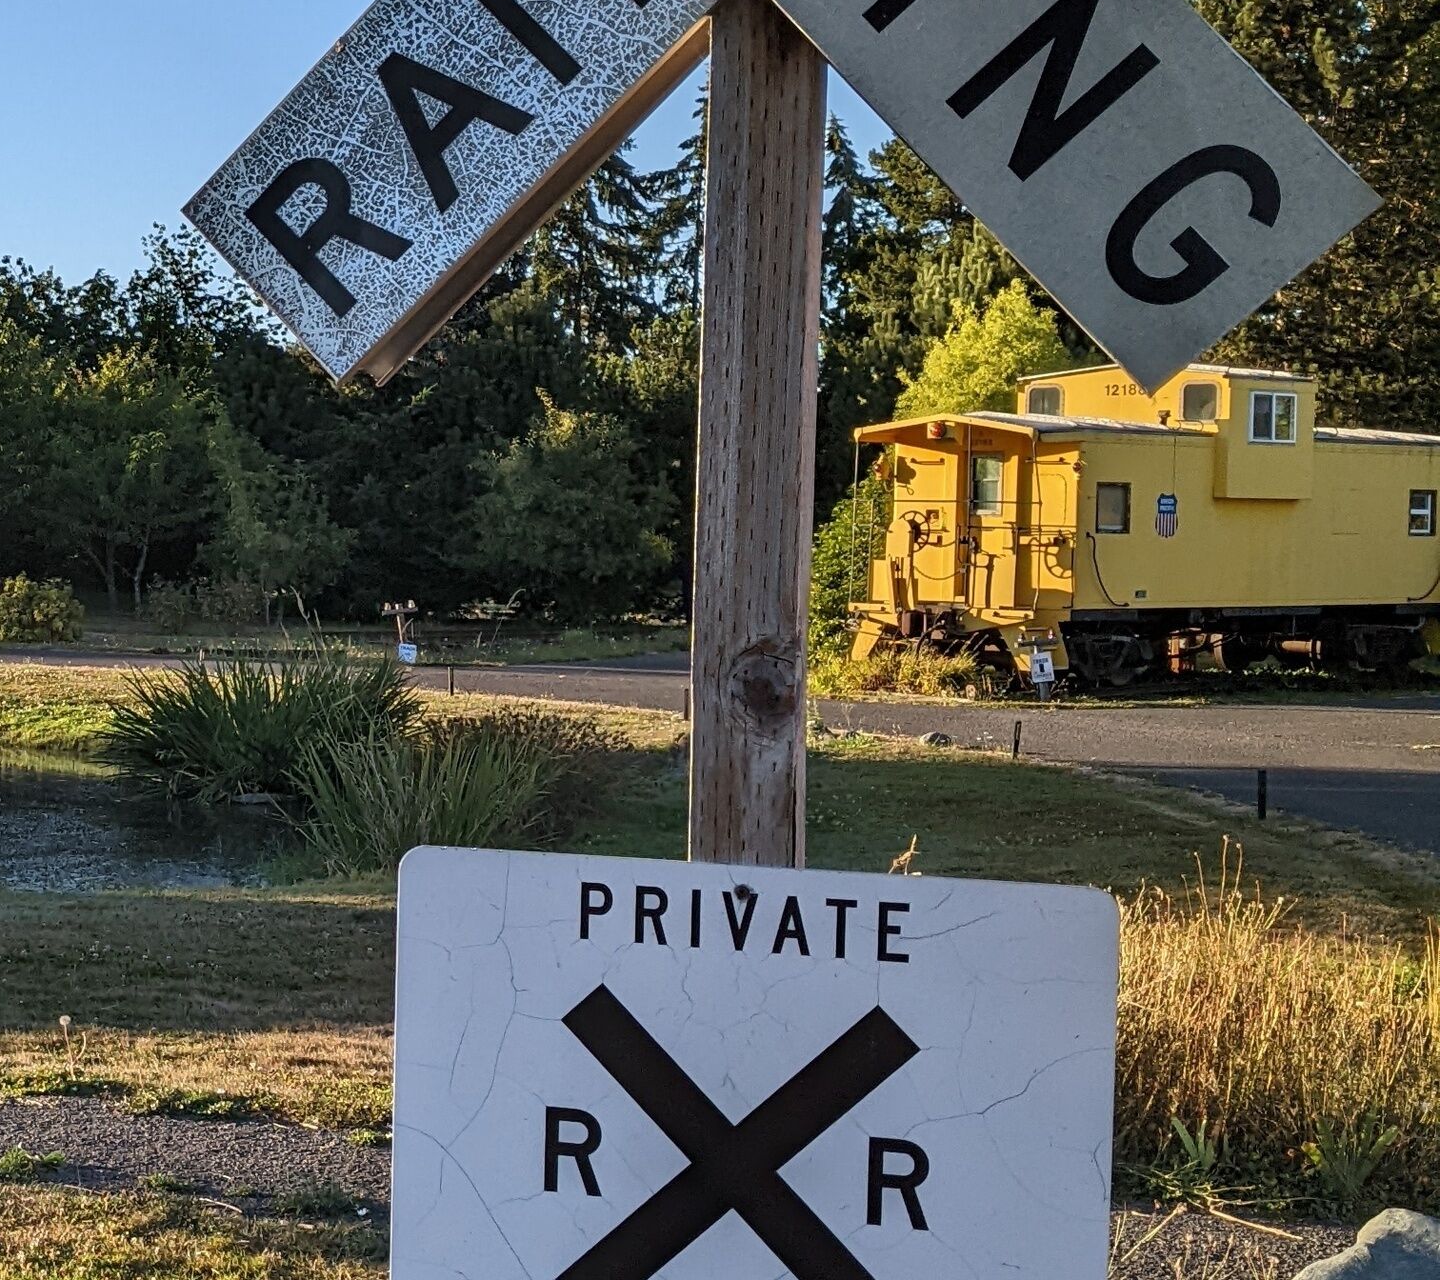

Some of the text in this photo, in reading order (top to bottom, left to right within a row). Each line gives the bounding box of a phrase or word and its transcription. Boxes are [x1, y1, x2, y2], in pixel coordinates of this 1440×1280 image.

[580, 882, 910, 963] PRIVATE
[544, 1106, 602, 1197] R
[867, 1136, 929, 1231] R
